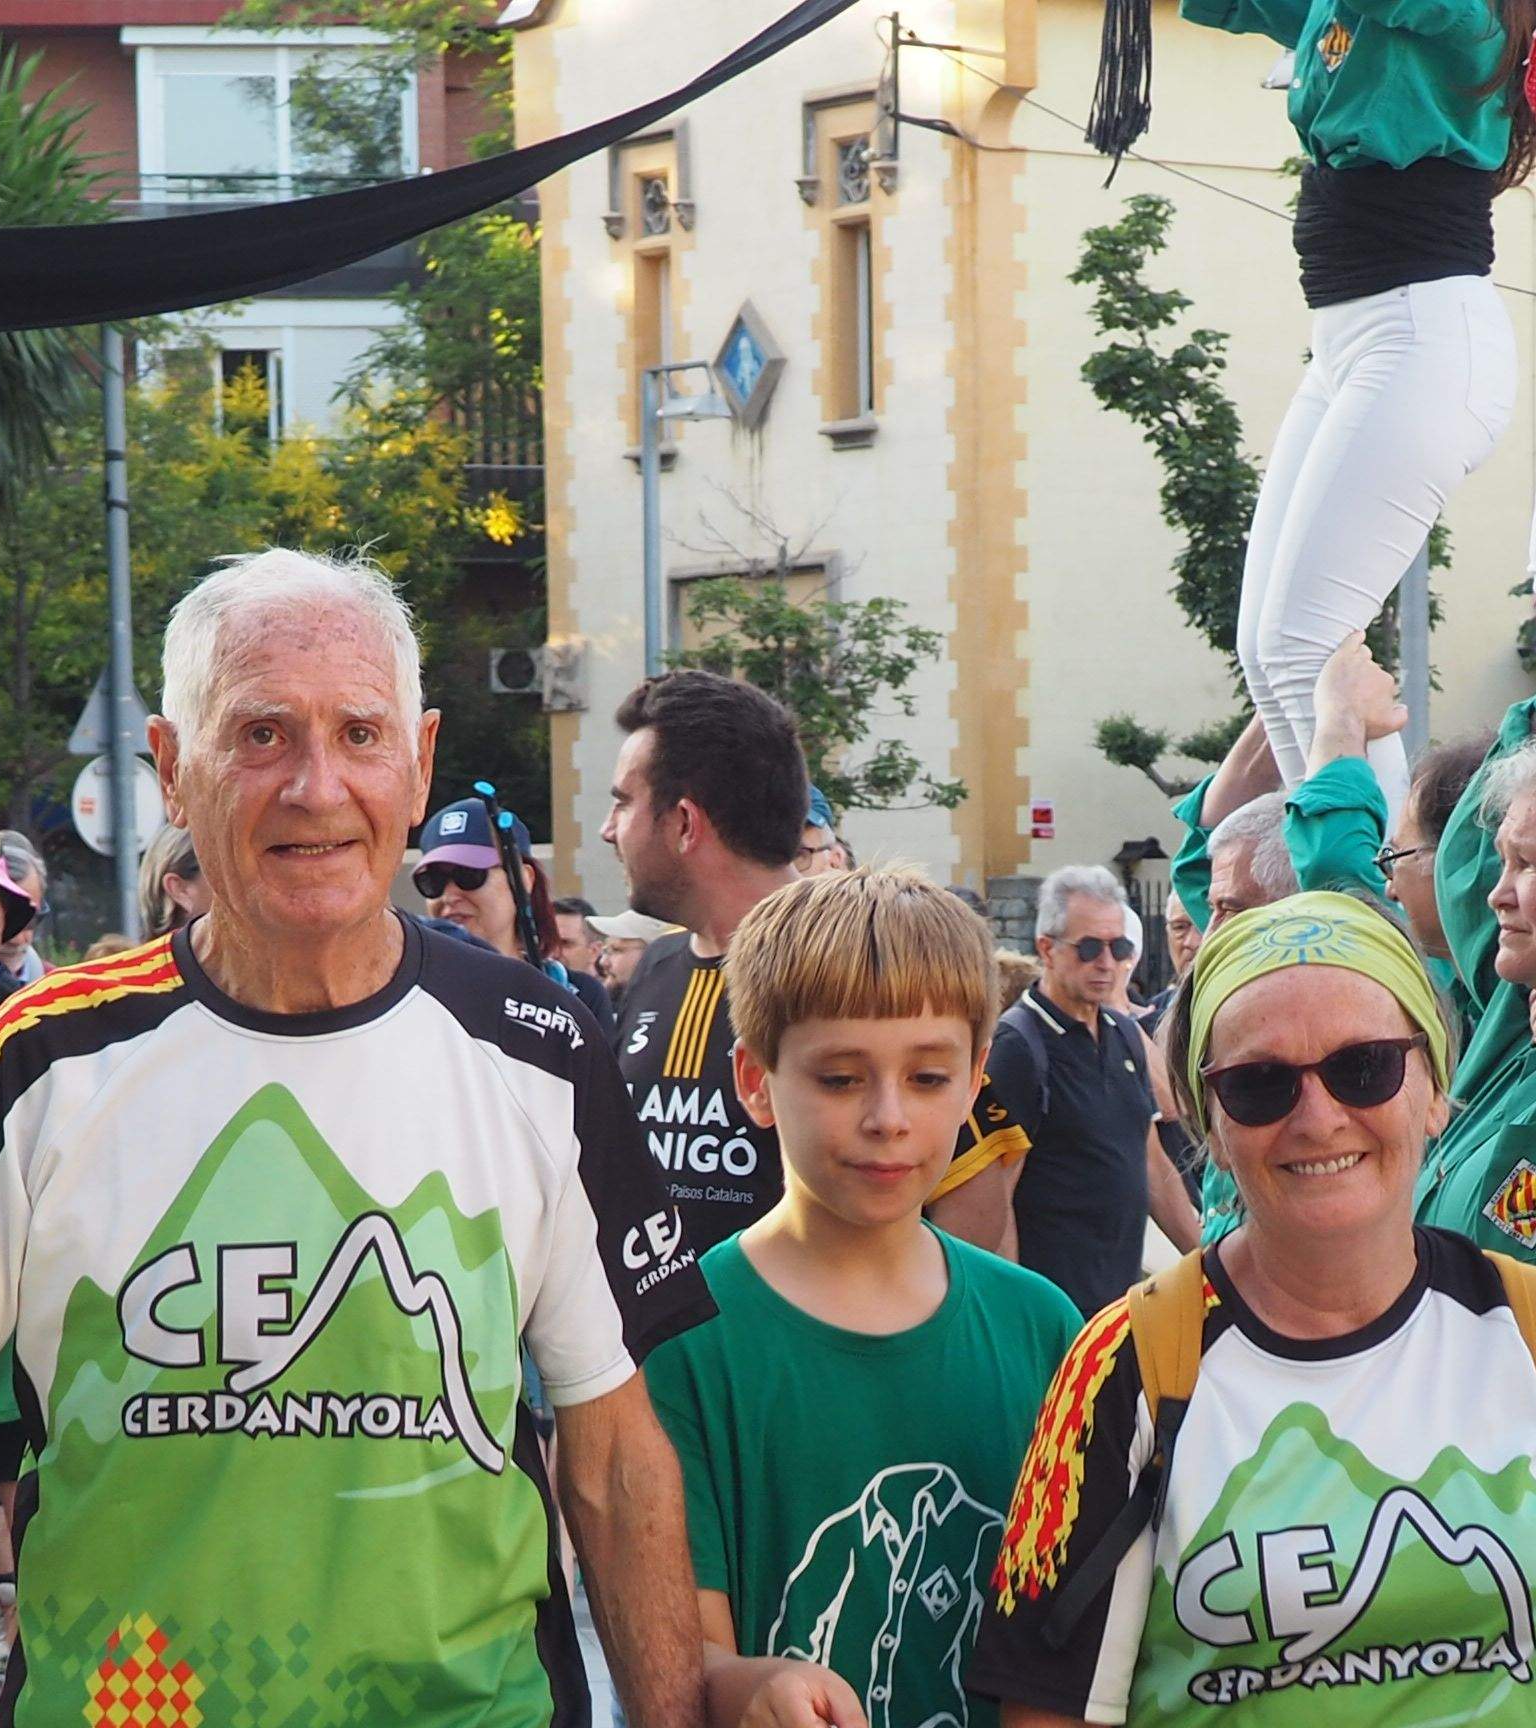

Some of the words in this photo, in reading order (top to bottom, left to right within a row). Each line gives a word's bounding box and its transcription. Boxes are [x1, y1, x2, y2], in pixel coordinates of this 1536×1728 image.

[504, 997, 585, 1051] SPORTY
[626, 1082, 731, 1128] AMA
[705, 1185, 754, 1204] Catalans
[635, 1247, 697, 1296] CERDAN
[121, 1389, 453, 1438] CERDANYOLA
[1188, 1637, 1518, 1705] CERDANYOLA
